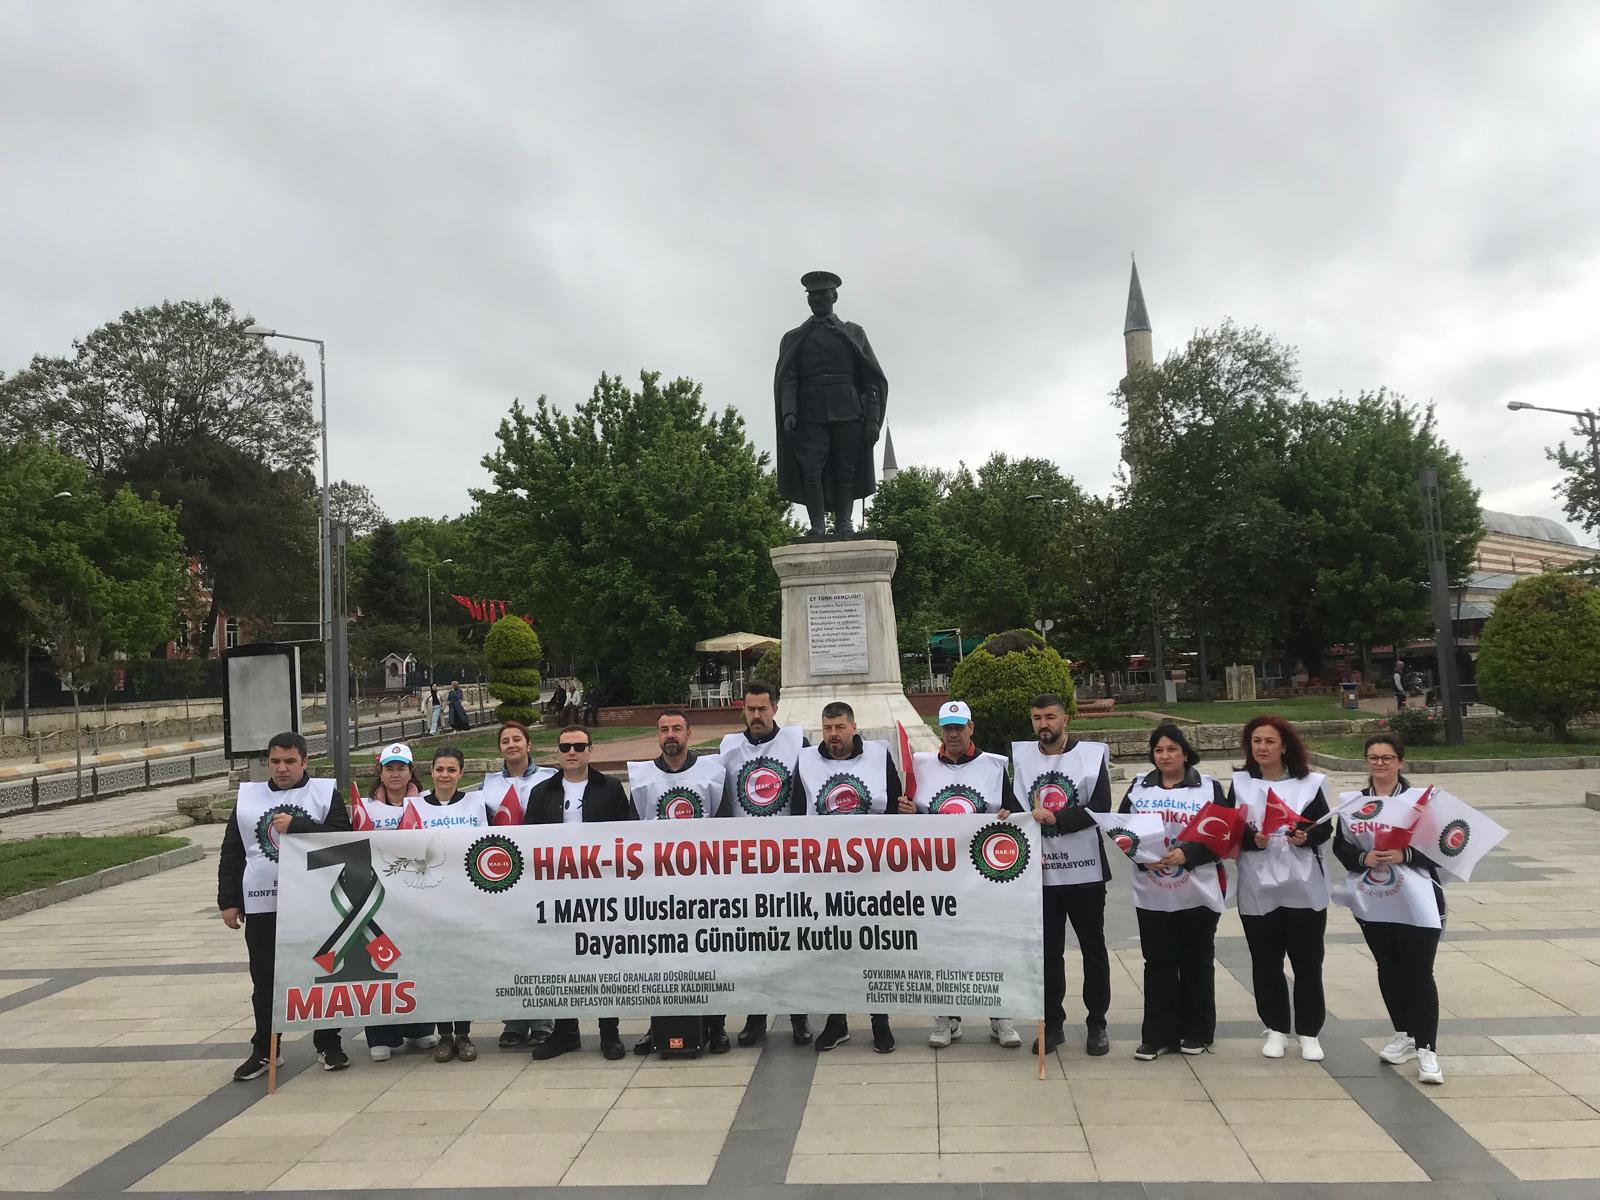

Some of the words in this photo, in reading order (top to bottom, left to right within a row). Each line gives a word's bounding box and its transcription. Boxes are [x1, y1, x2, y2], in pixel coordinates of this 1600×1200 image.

[1135, 797, 1150, 808] ÖZ
[430, 815, 478, 828] SAĞLIK-İŞ
[533, 837, 644, 880] HAK-İŞ
[654, 837, 957, 877] KONFEDERASYONU
[535, 900, 547, 924] 1
[554, 897, 618, 923] MAYIS
[624, 894, 748, 922] Uluslararası
[755, 892, 819, 921] Birlik,
[825, 890, 925, 917] Mücadele
[931, 895, 957, 917] ve
[575, 932, 688, 959] Dayanışma
[695, 926, 791, 953] Günümüz
[797, 925, 853, 951] Kutlu
[859, 925, 918, 951] Olsun
[514, 974, 566, 985] ÜCRETLERDEN
[568, 973, 597, 984] ALINAN
[598, 972, 621, 983] VERGİ
[623, 972, 661, 982] ORANLARI
[863, 969, 906, 980] SOYKIRIMA
[908, 969, 934, 981] HAYIR,
[975, 971, 1004, 982] DESTEK
[495, 986, 533, 997] SENDİKAL
[534, 984, 599, 996] ÖRGÜTLENMENİN
[600, 983, 640, 995] ÖNÜNDEKİ
[642, 983, 679, 993] ENGELLER
[681, 982, 735, 993] KALDIRILMALI
[868, 981, 904, 992] GAZZE'YE
[906, 982, 934, 993] SELAM,
[973, 983, 999, 994] DEVAM
[286, 980, 418, 1022] MAYIS
[522, 997, 568, 1008] ÇALIŞANLAR
[570, 996, 613, 1007] ENFLASYON
[615, 995, 661, 1006] KARŞISINDA
[663, 995, 709, 1005] KORUNMALI
[866, 992, 898, 1004] FİLİSTİN
[900, 992, 922, 1004] BİZİM
[924, 994, 953, 1005] KIRMIZI
